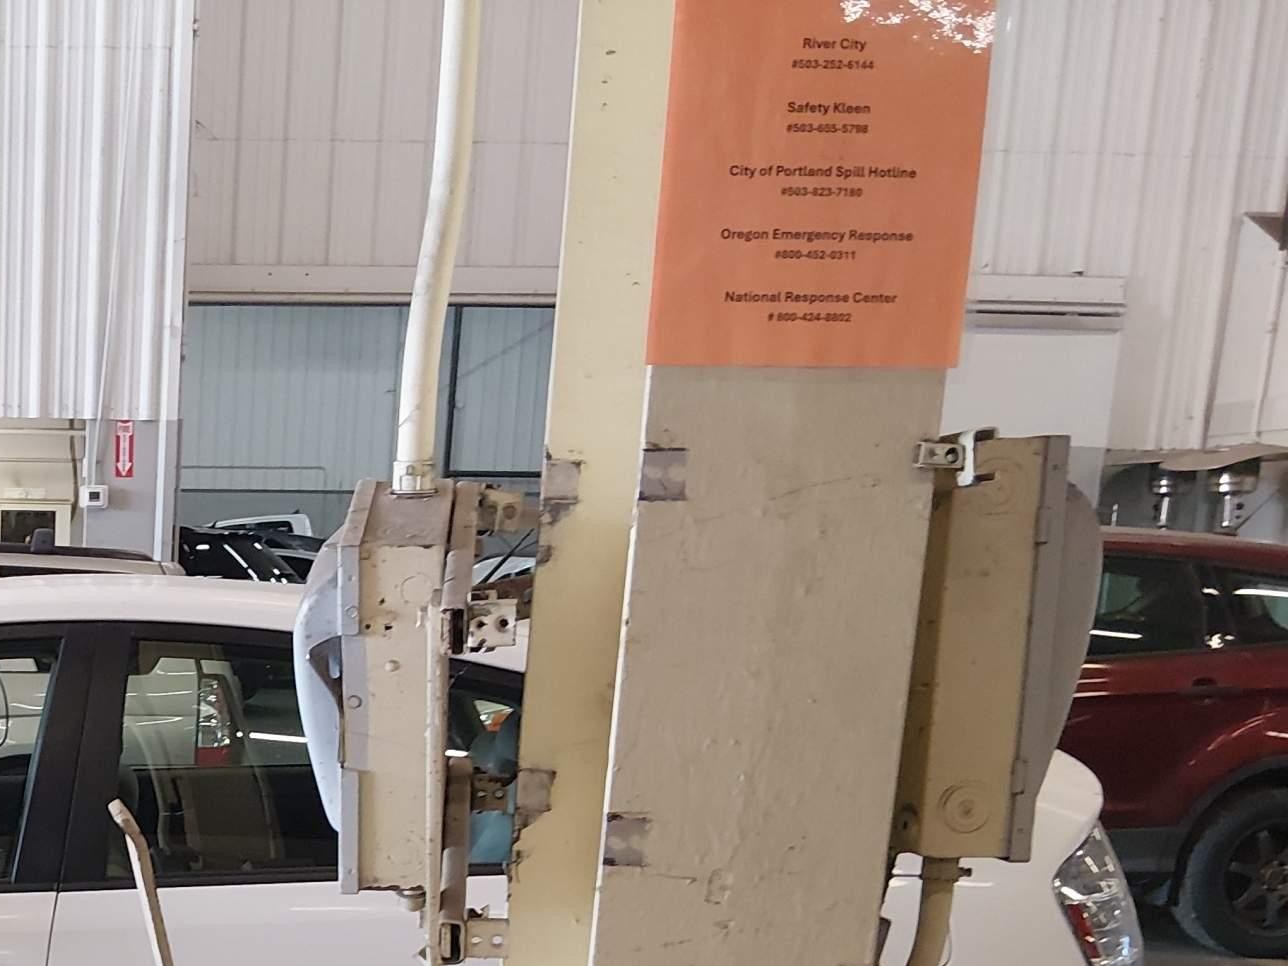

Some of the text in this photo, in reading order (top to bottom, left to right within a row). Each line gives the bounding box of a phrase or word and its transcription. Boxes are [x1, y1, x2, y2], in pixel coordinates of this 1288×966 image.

[802, 37, 867, 53] River City
[787, 101, 871, 116] Safety Kleen
[729, 165, 917, 180] City of Portland Spill Hotline
[720, 228, 914, 243] Oregon Emergency Response
[724, 291, 898, 305] National Response Center
